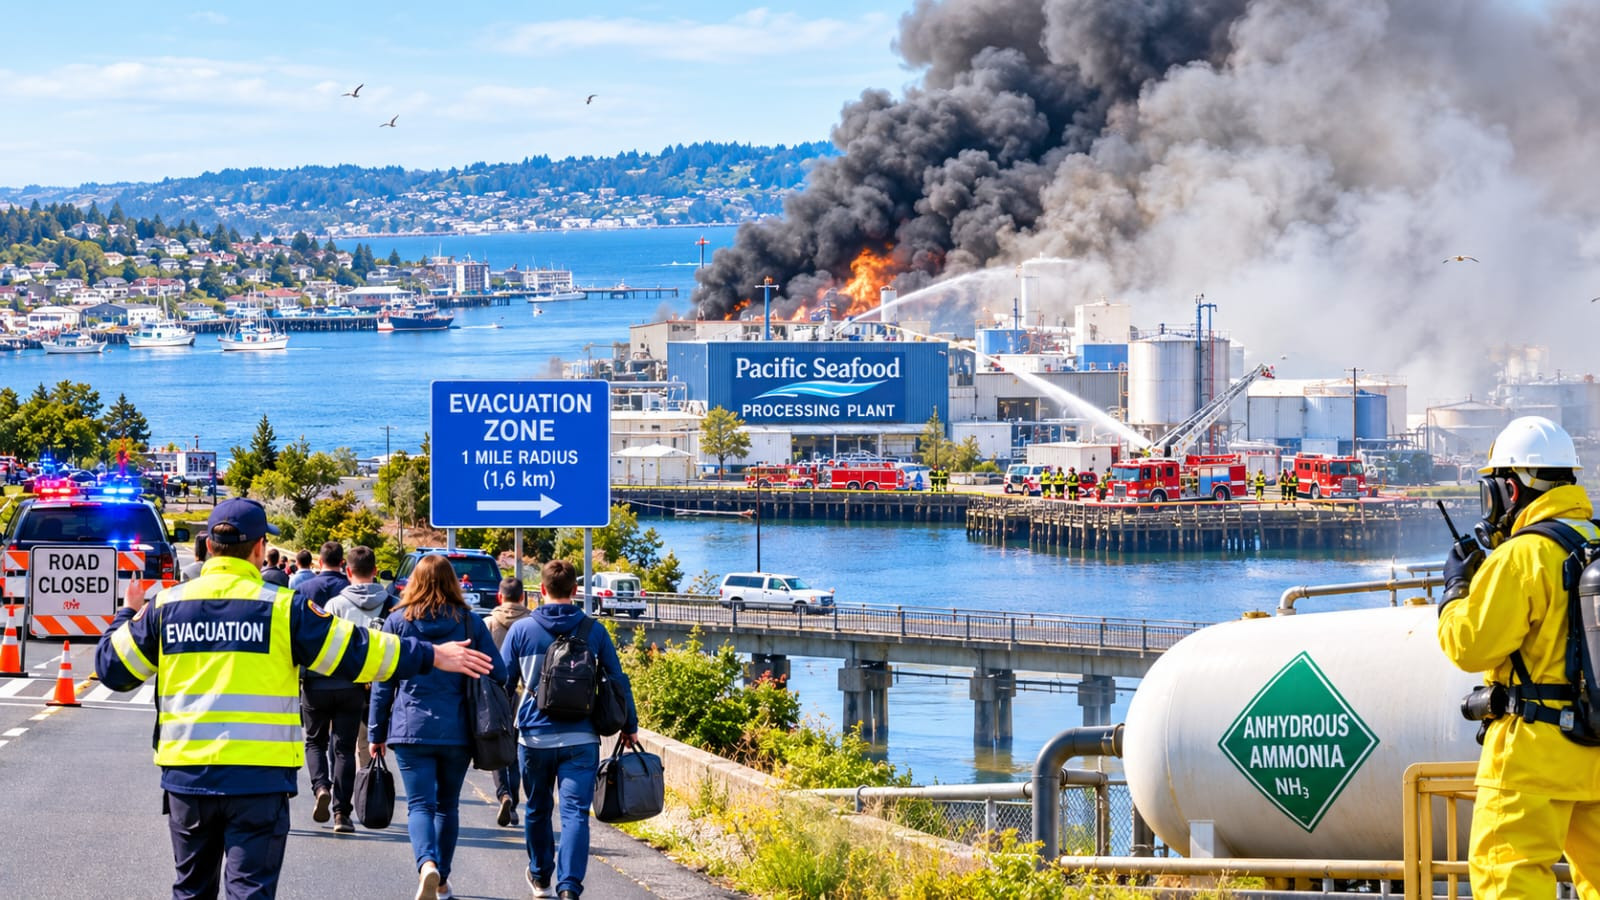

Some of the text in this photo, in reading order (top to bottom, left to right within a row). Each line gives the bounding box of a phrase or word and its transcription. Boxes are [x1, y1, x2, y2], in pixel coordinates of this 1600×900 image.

[736, 357, 900, 379] Pacific Seafood
[449, 393, 592, 413] EVACUATION
[742, 404, 896, 417] PROCESSING PLANT
[483, 419, 555, 441] ZONE
[461, 450, 578, 465] 1 MILE RADIUS
[483, 470, 556, 490] (1,6 km)
[49, 553, 99, 570] ROAD
[38, 576, 109, 593] CLOSED
[166, 621, 264, 644] EVACUATION
[1243, 713, 1350, 739] ANHYDROUS
[1249, 744, 1346, 768] AMMONIA
